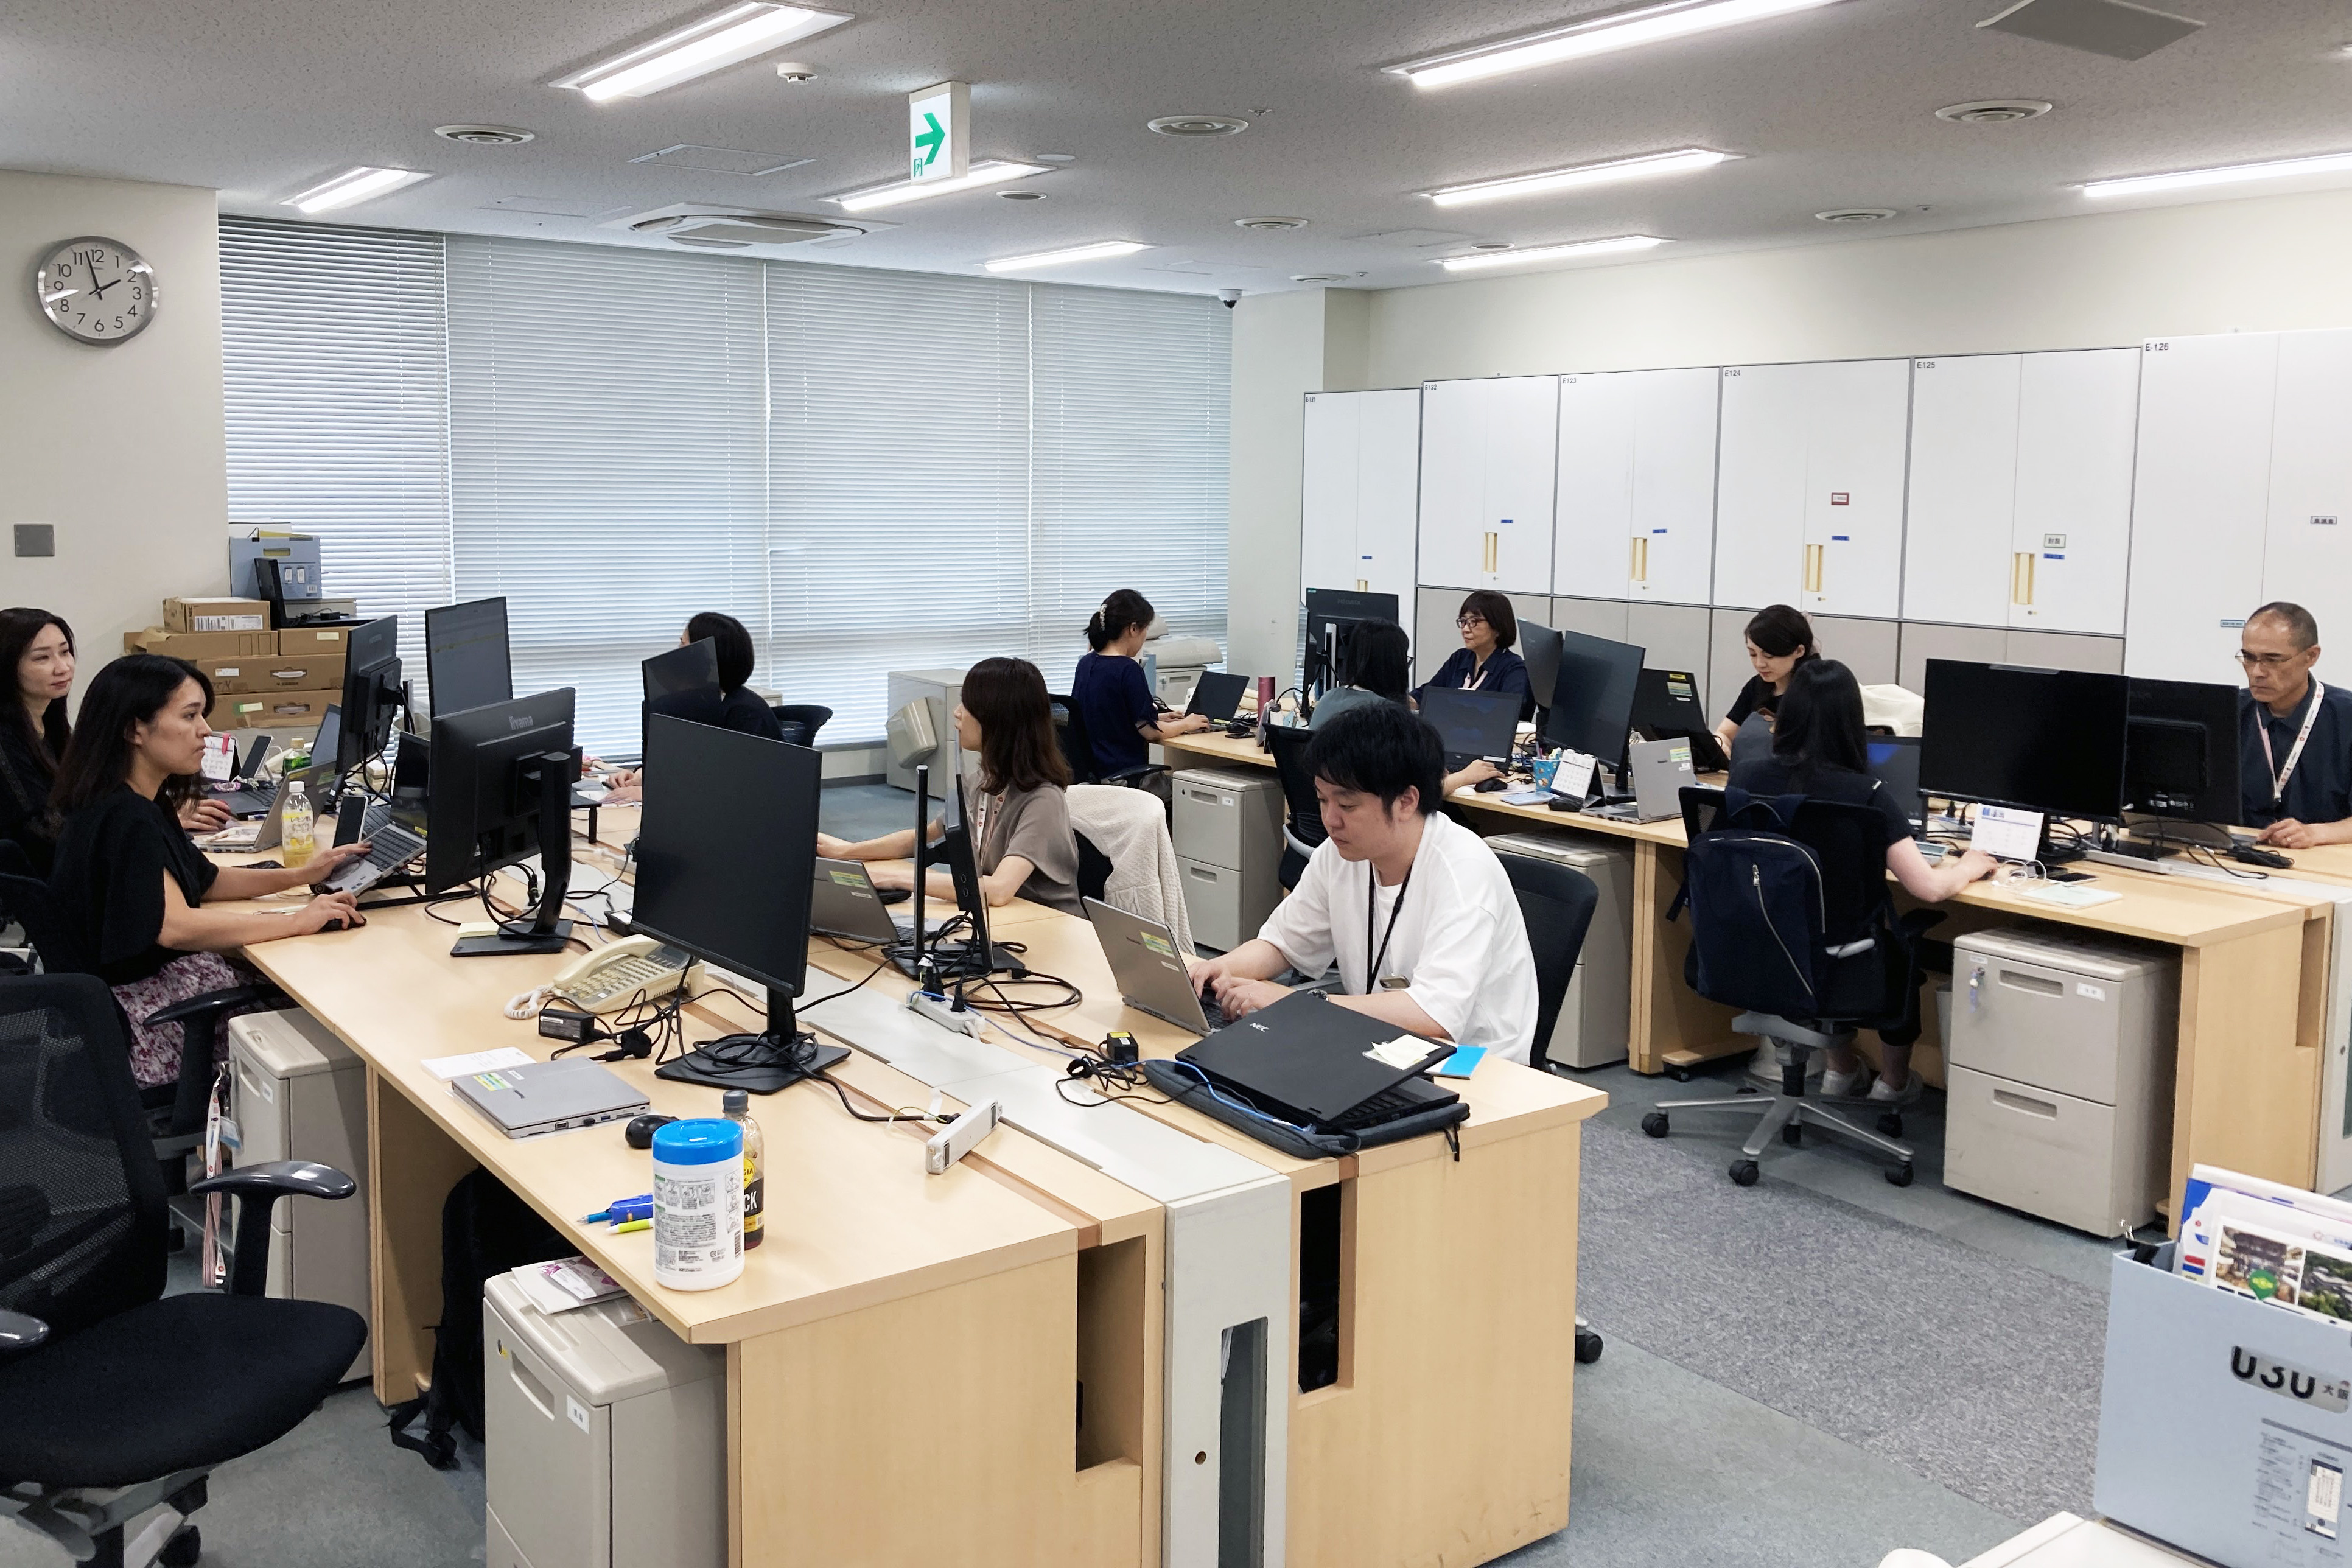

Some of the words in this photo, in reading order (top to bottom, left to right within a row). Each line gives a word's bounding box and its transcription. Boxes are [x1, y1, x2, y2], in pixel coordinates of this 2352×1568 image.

[73, 252, 83, 265] 11
[91, 249, 104, 263] 12
[115, 255, 119, 268] 1
[57, 264, 72, 278] 10
[127, 269, 136, 282] 2
[133, 287, 142, 300] 3
[60, 299, 69, 312] 8
[127, 304, 138, 317] 4
[77, 313, 86, 325] 7
[94, 319, 105, 332] 6
[114, 316, 124, 329] 5
[2145, 342, 2169, 351] E-126
[1249, 1022, 1269, 1032] NEC
[744, 1191, 758, 1212] CK
